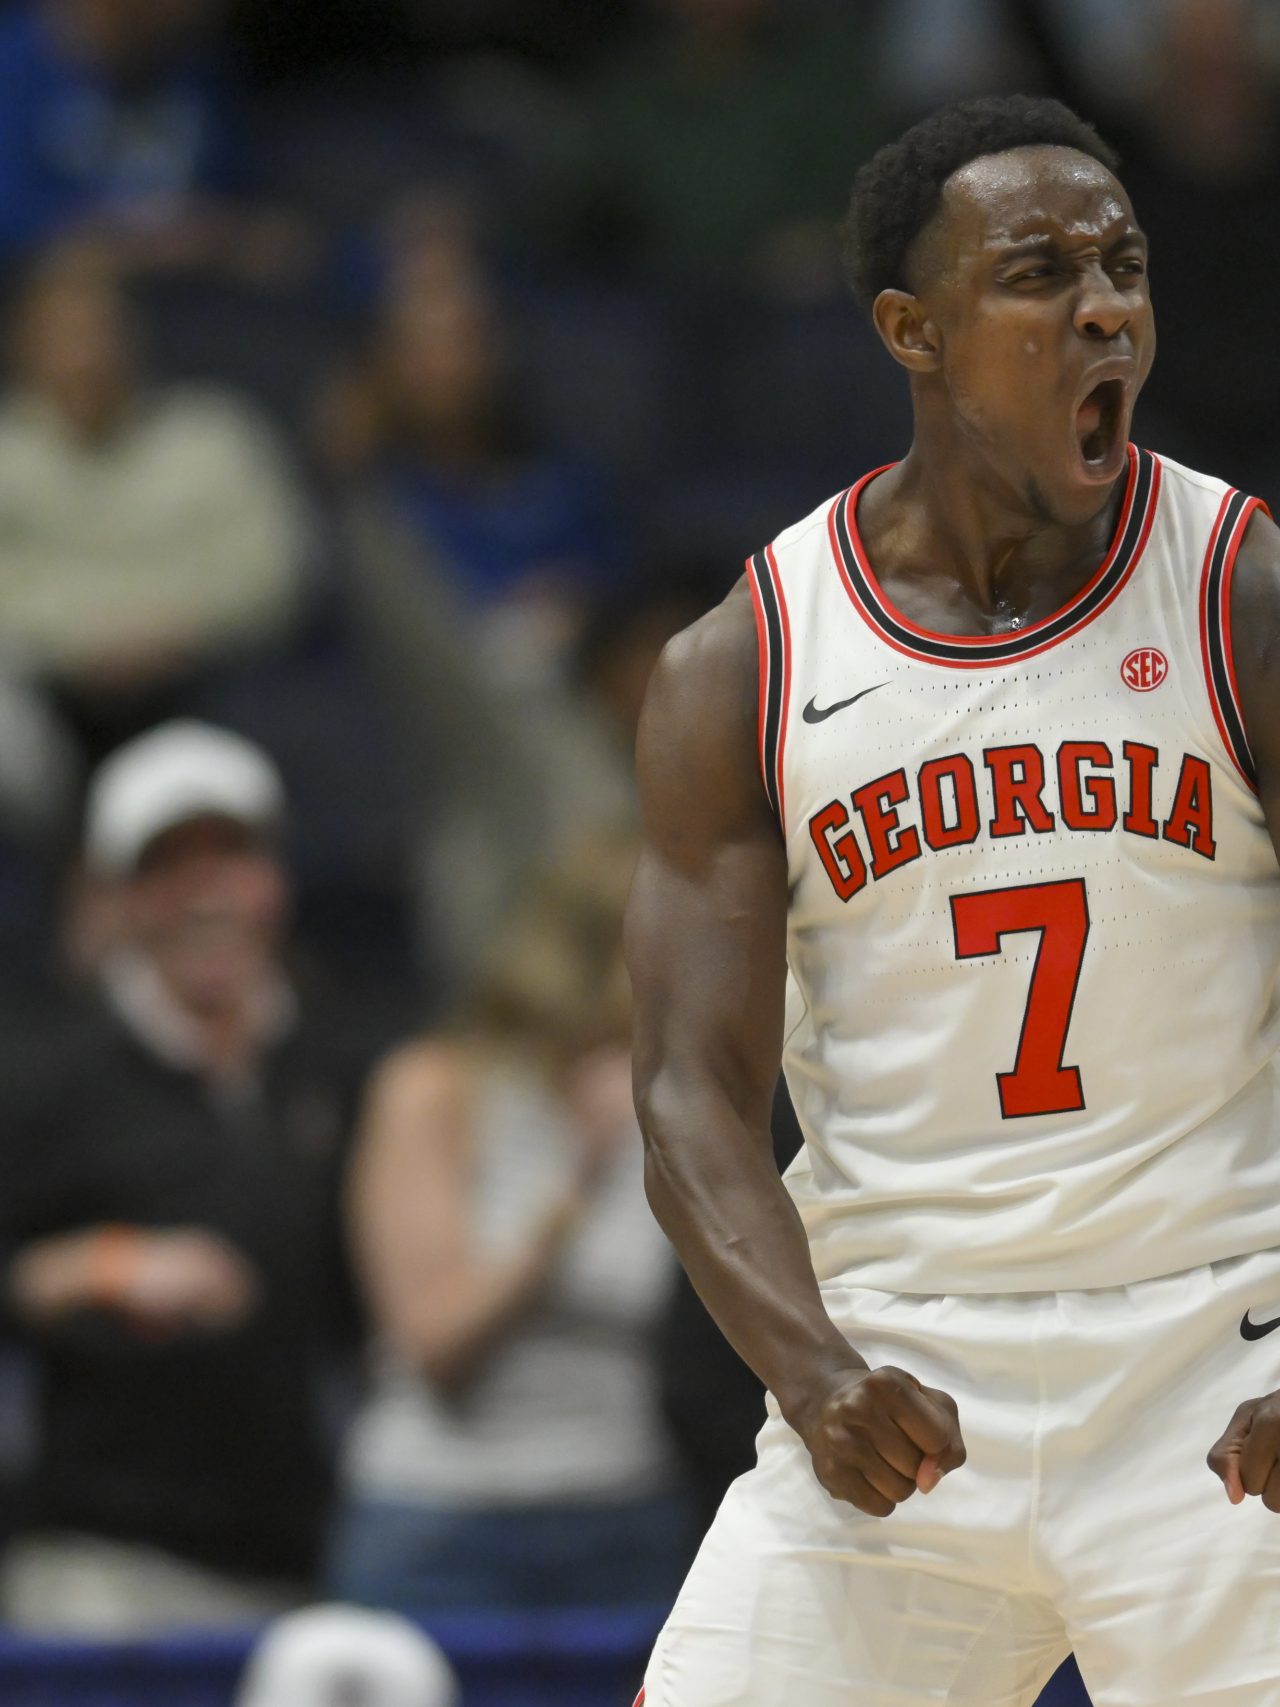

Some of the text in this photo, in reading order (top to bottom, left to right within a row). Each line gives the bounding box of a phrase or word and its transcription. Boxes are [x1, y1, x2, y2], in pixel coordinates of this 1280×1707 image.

[1125, 651, 1164, 688] SEC
[808, 740, 1216, 902] GEORGIA
[949, 877, 1090, 1119] 7
